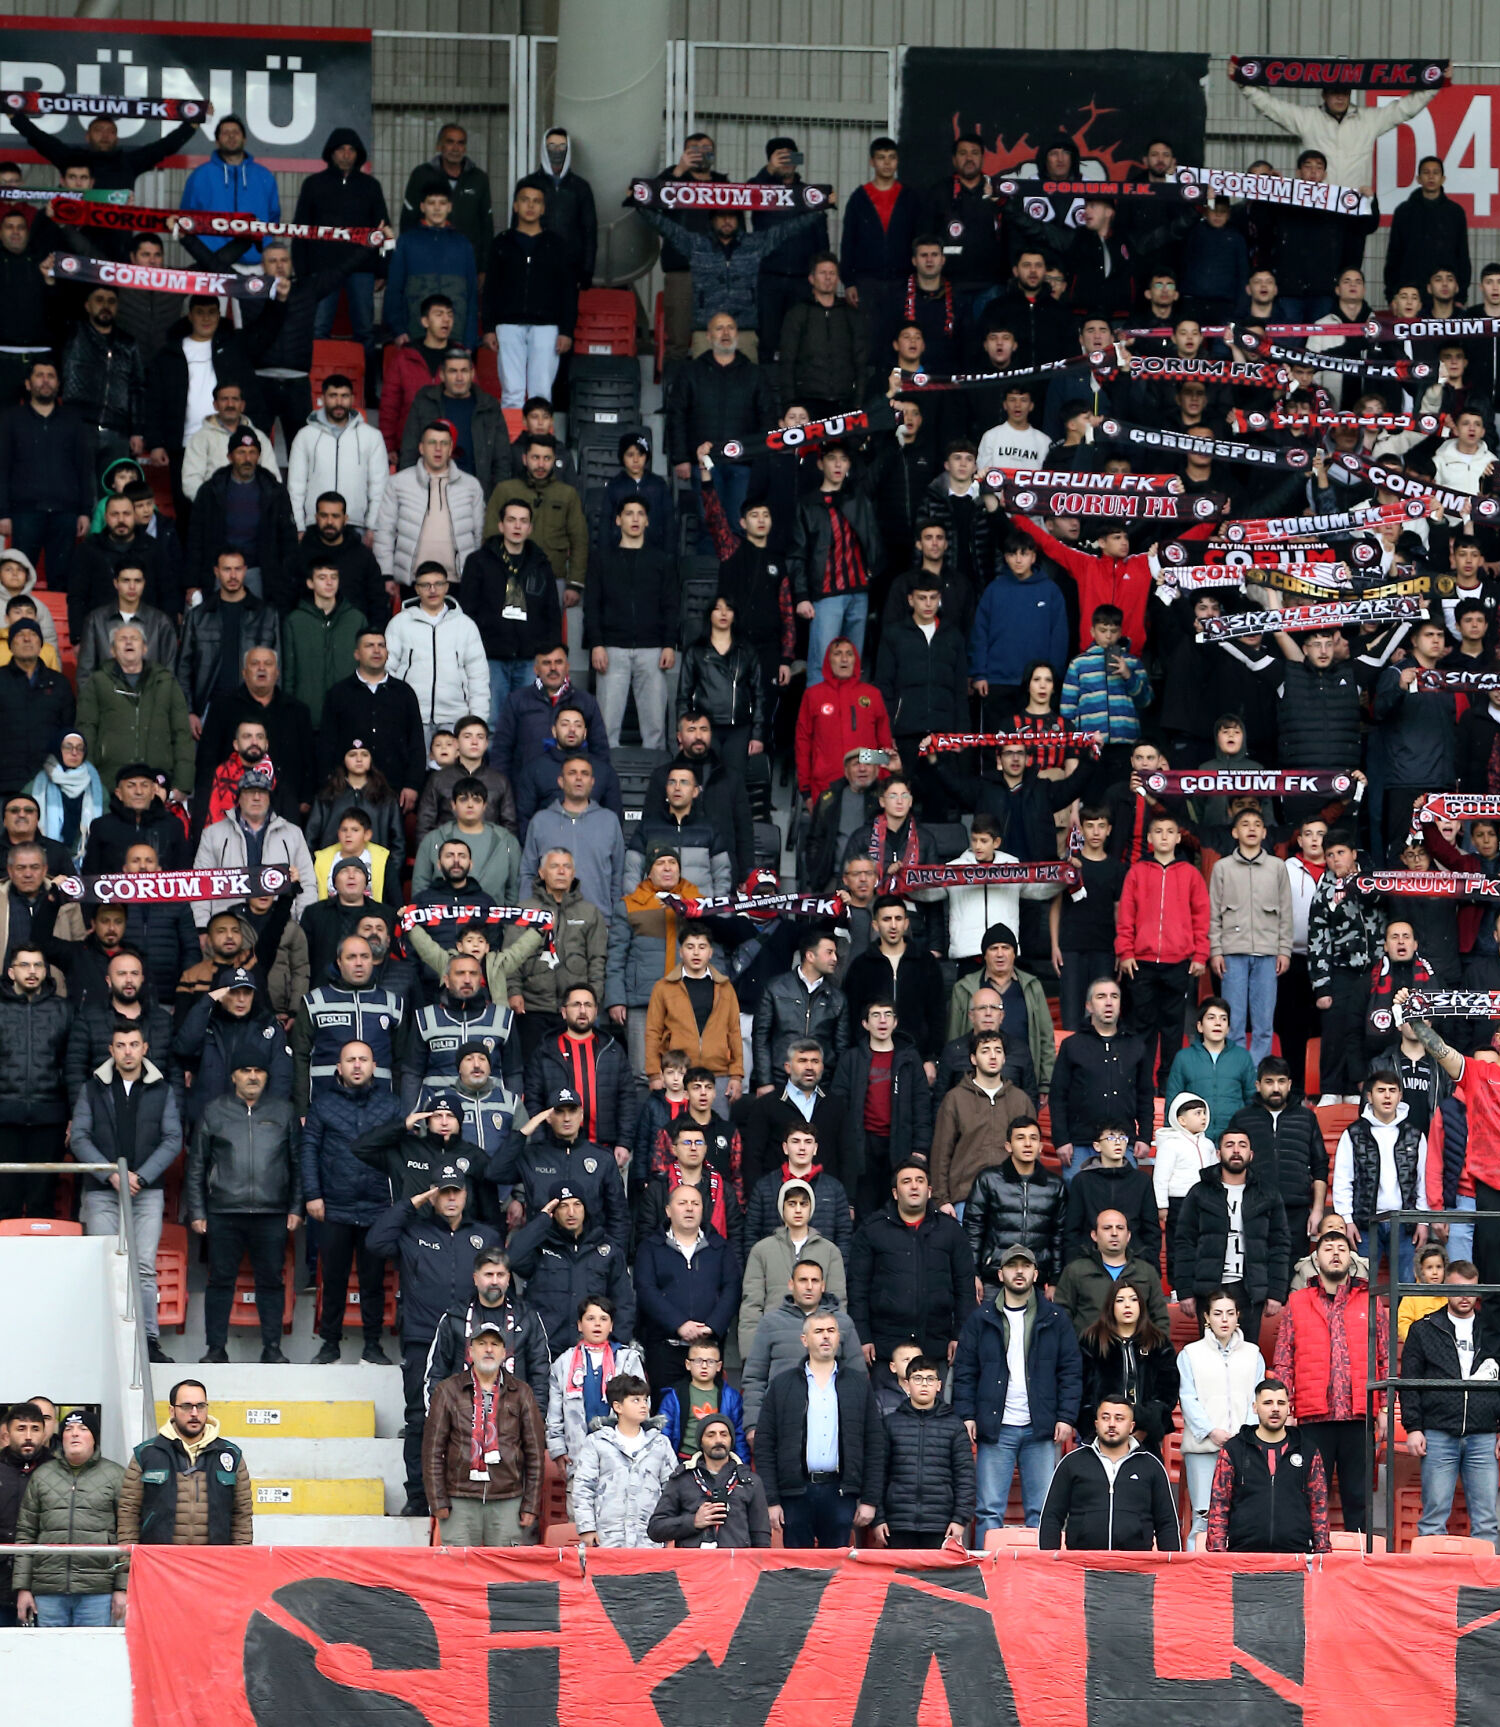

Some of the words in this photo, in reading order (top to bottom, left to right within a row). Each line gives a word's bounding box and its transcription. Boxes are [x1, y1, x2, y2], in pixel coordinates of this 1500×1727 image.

[1265, 61, 1363, 85] ÇORUM
[1369, 63, 1417, 84] F.K.
[37, 98, 127, 114] ÇORUM
[136, 101, 169, 117] FK
[1376, 95, 1499, 217] D4
[660, 185, 755, 209] ÇORUM
[760, 187, 795, 208] FK
[1211, 172, 1293, 199] ÇORUM
[1299, 182, 1328, 205] FK
[316, 225, 351, 240] FK
[194, 276, 227, 295] FK
[1393, 321, 1484, 339] ÇORUM
[1130, 356, 1227, 378] ÇORUM
[1231, 360, 1267, 380] FK
[998, 446, 1039, 461] LUFIAN
[1129, 427, 1277, 465] ÇORUMSPOR
[1014, 470, 1116, 489] ÇORUM
[1120, 474, 1157, 492] FK
[1050, 491, 1140, 518] ÇORUM
[1144, 495, 1178, 519] FK
[1266, 512, 1353, 539] ÇORUM
[1357, 506, 1384, 526] FK
[1362, 575, 1431, 600] SPOR
[1308, 599, 1391, 618] DUVAR
[1180, 775, 1277, 794] ÇORUM
[1284, 776, 1319, 792] FK
[905, 868, 959, 885] ARCA
[963, 867, 1030, 886] ÇORUM
[1036, 866, 1061, 880] FK
[1356, 874, 1457, 893] ÇORUM
[1465, 877, 1500, 897] FK
[93, 878, 202, 905] ÇORUM
[211, 874, 252, 896] FK
[488, 905, 553, 926] SPOR
[800, 898, 835, 915] FK
[1468, 1006, 1497, 1017] Doğru
